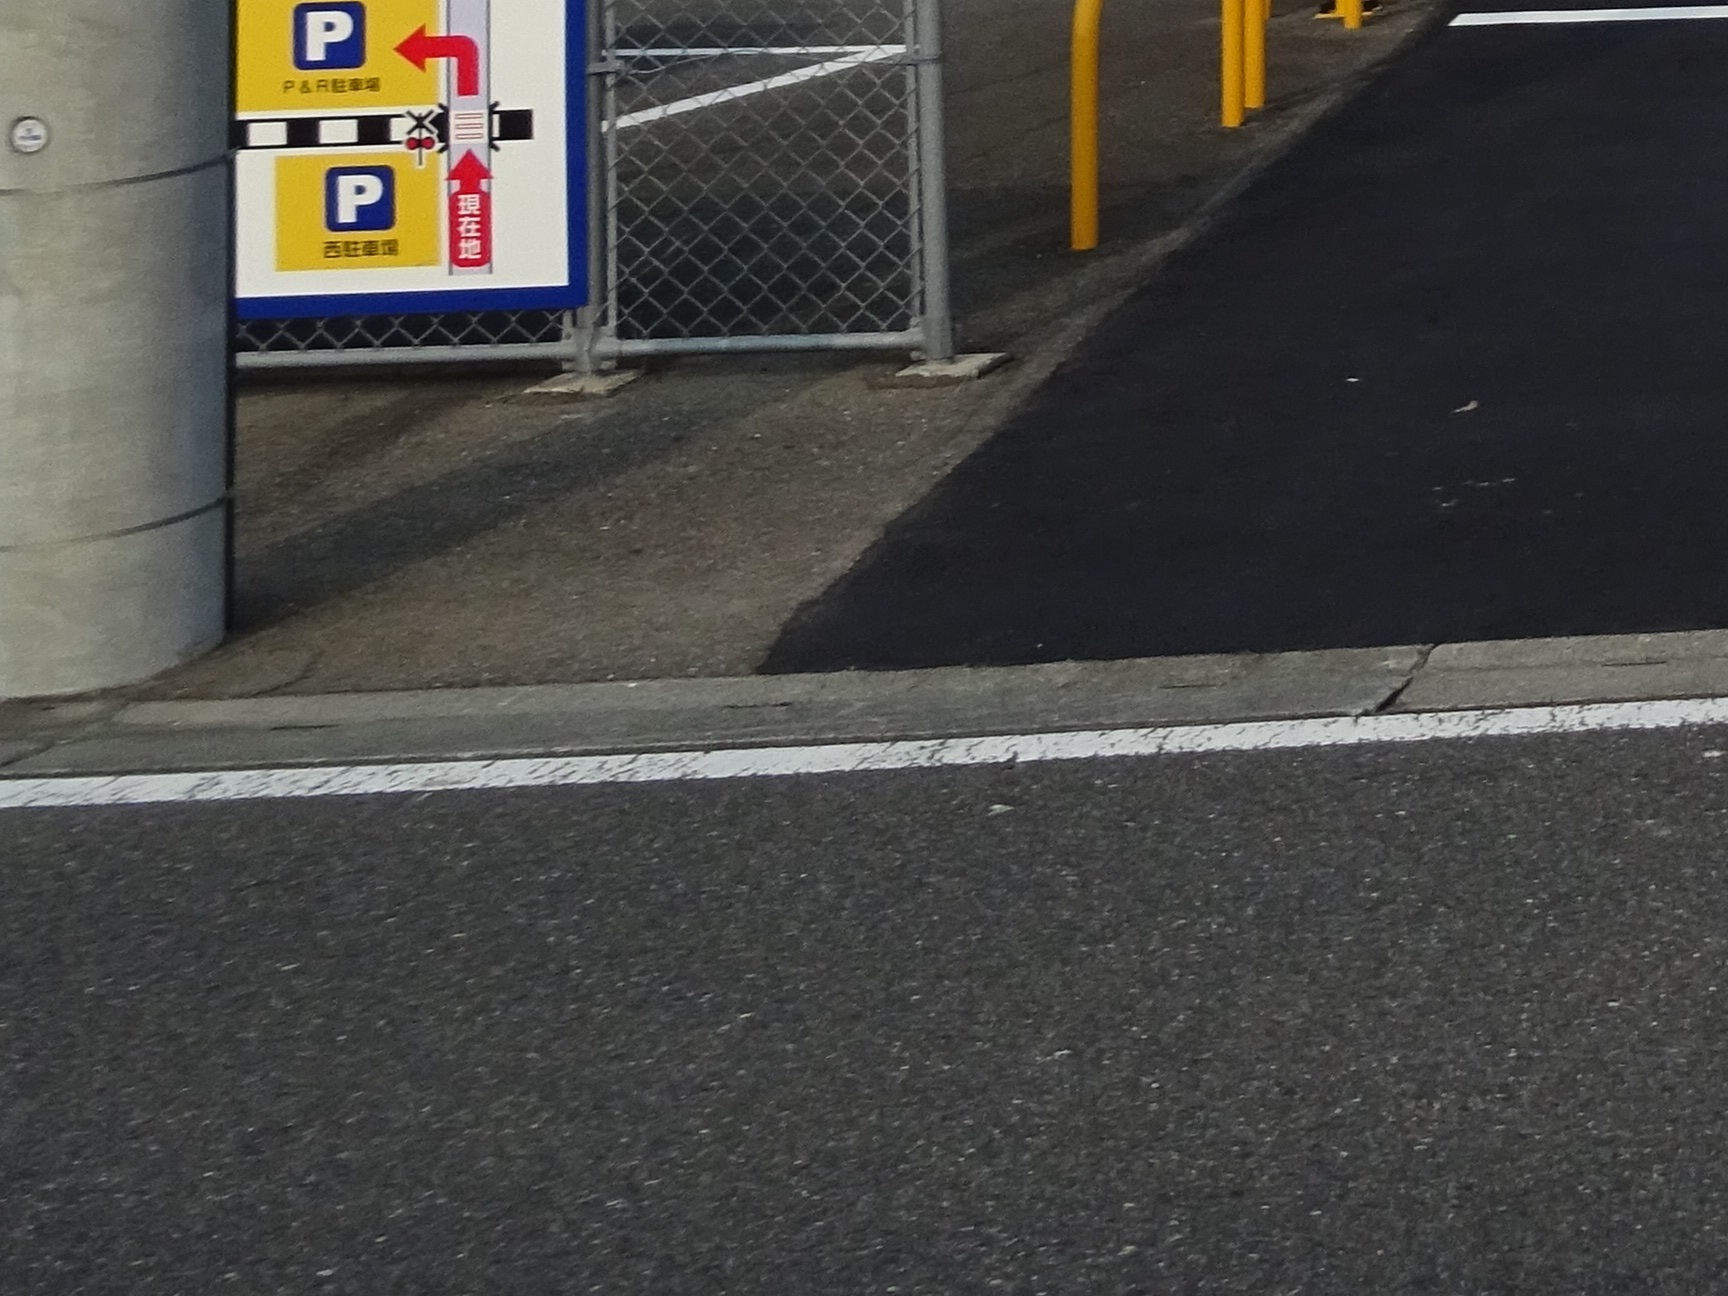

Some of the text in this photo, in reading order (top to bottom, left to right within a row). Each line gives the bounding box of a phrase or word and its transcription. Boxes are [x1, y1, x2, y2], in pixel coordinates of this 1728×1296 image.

[304, 10, 355, 62] P
[337, 173, 384, 224] P
[323, 239, 399, 259] 西駐車場
[457, 193, 482, 260] 現在地
